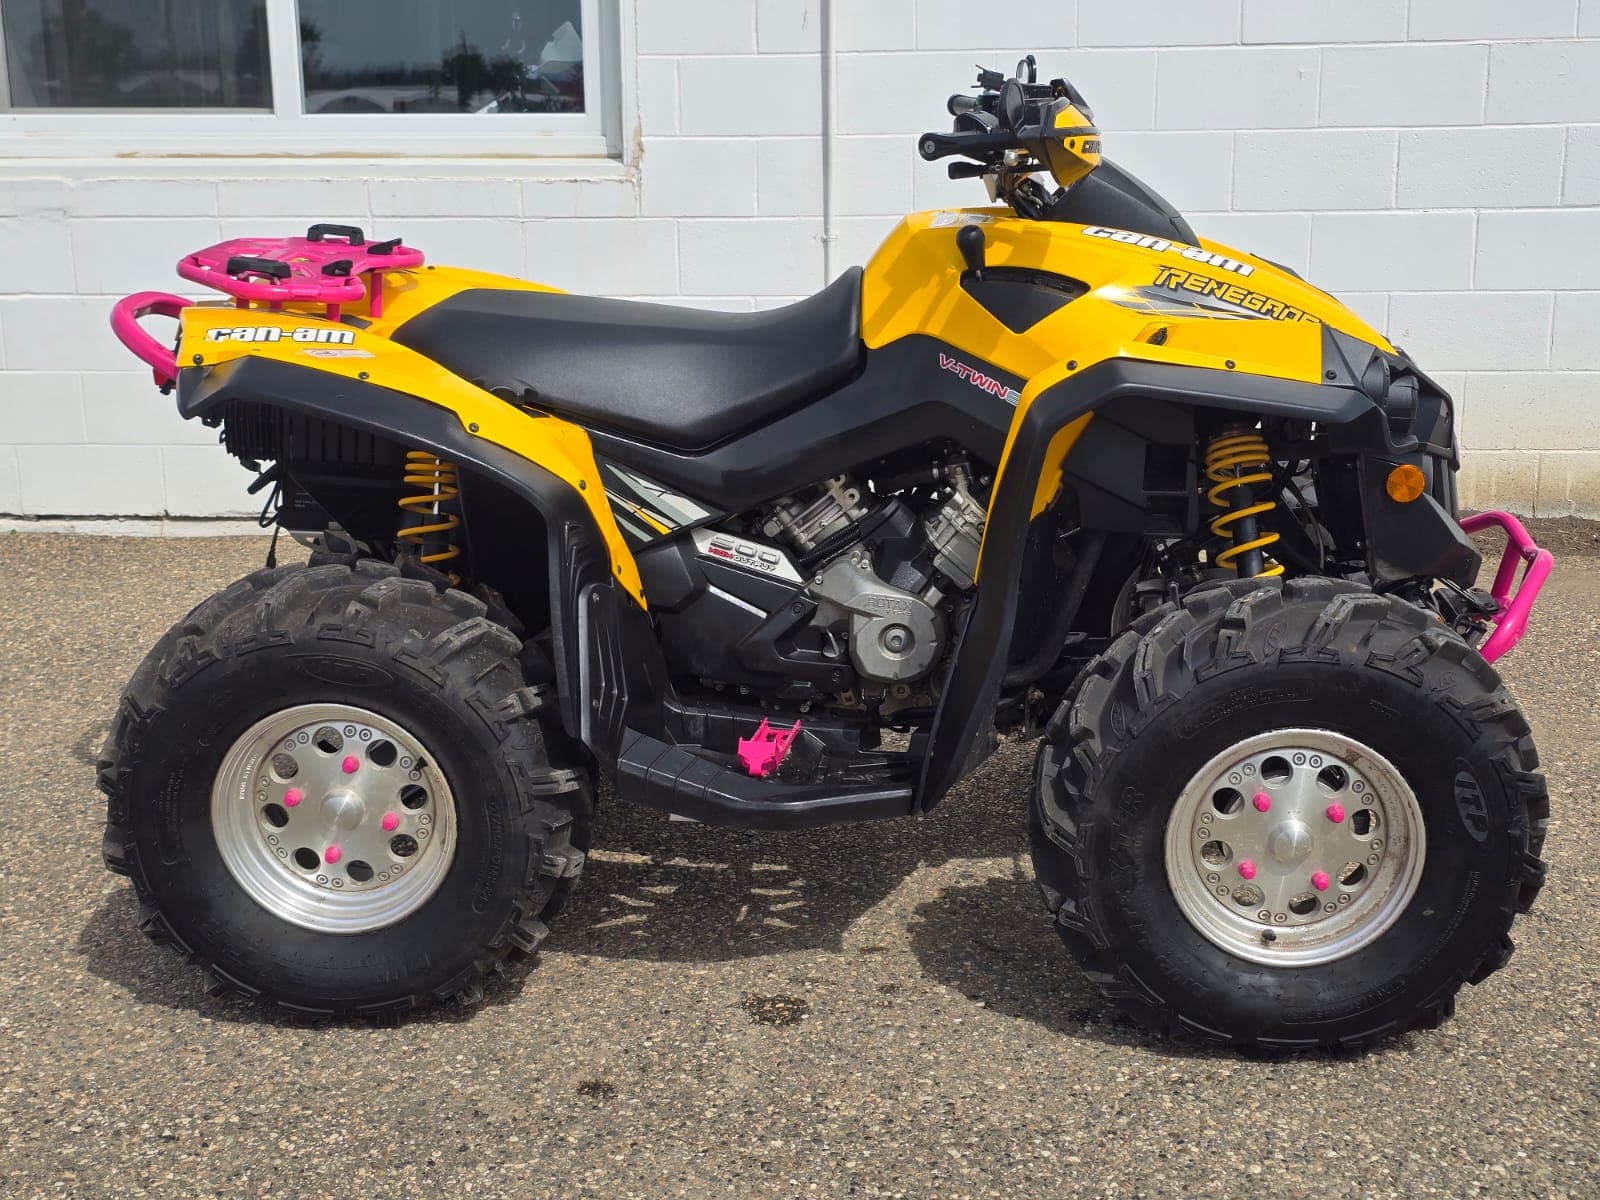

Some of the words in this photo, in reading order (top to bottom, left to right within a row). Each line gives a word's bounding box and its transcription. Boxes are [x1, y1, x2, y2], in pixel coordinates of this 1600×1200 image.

[1081, 226, 1255, 277] can-am
[204, 327, 355, 345] can-am
[939, 352, 1009, 399] V-TWIN
[710, 536, 780, 565] 500
[734, 554, 776, 572] OUTPUT
[867, 595, 913, 611] ROTAX
[1455, 779, 1489, 833] ITP
